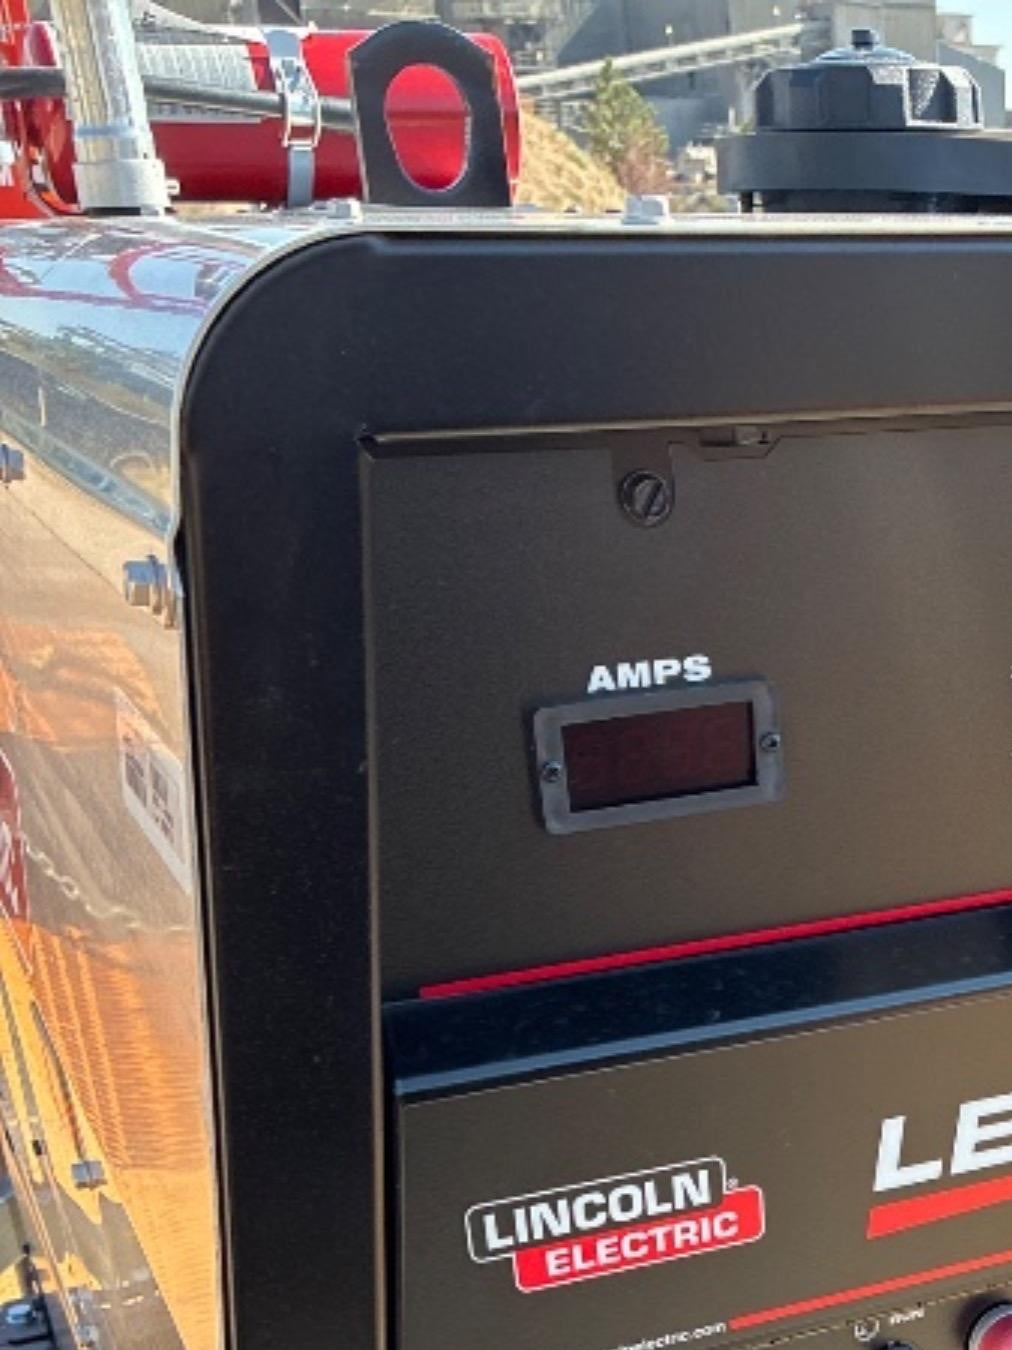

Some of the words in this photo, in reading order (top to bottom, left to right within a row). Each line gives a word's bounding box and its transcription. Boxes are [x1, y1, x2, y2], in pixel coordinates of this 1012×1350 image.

[587, 653, 713, 695] AMPS
[483, 1168, 713, 1251] LINCOLN
[545, 1210, 740, 1277] ELECTRIC
